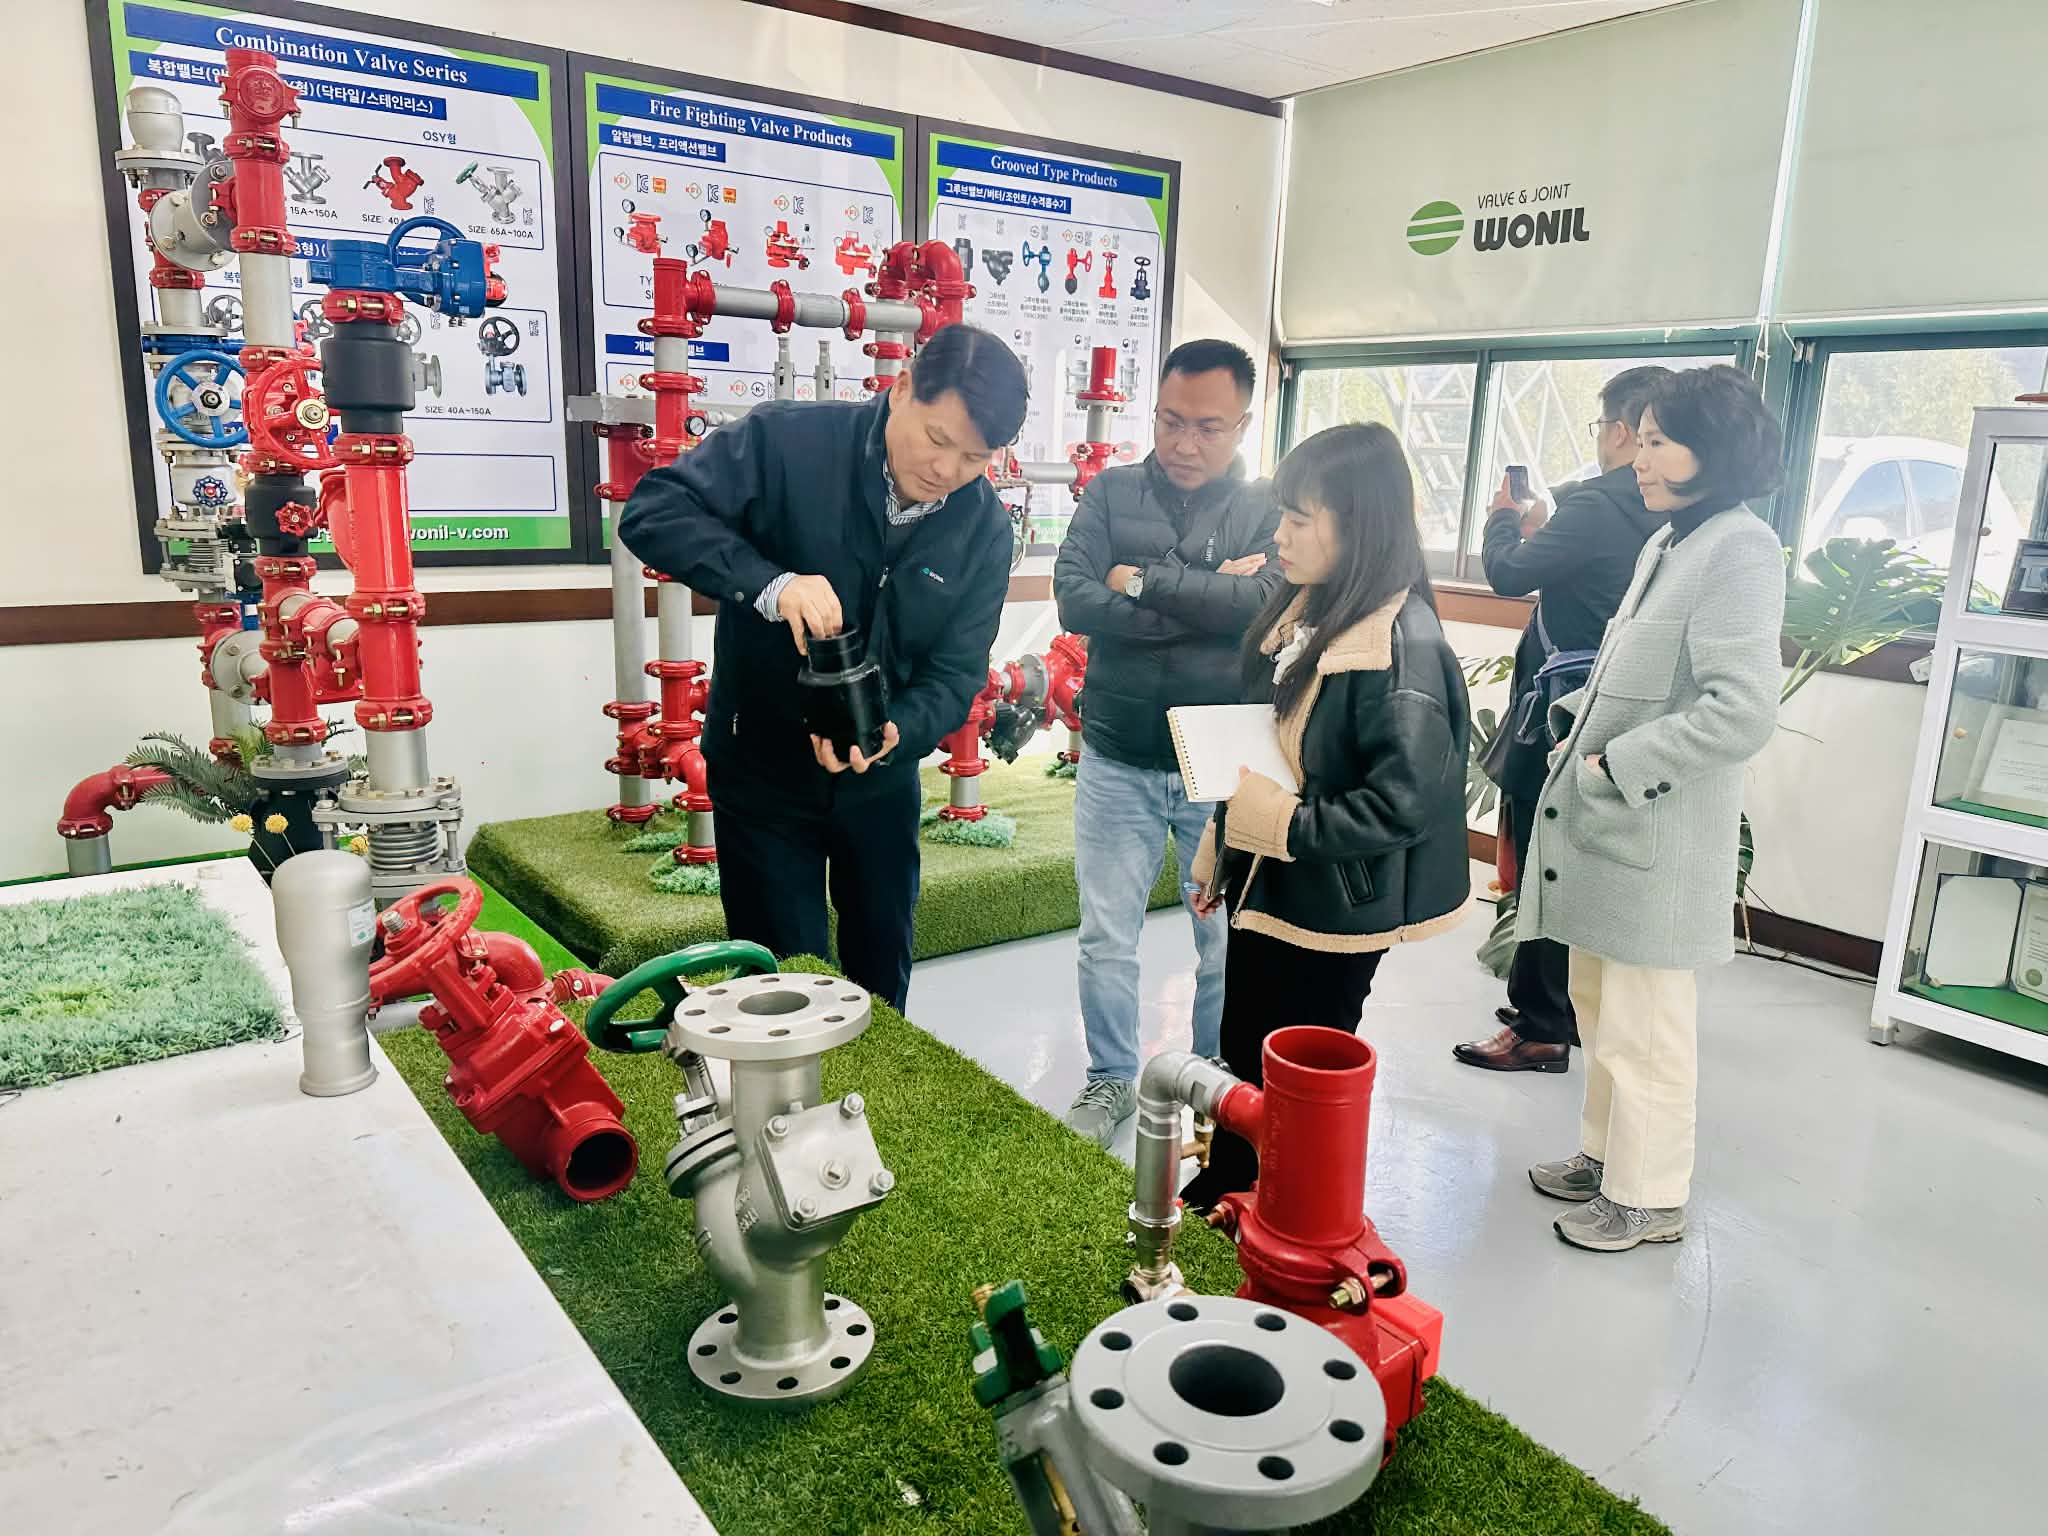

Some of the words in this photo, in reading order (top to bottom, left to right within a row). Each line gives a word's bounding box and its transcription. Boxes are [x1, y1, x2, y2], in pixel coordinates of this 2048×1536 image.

[215, 26, 349, 65] Combination
[353, 48, 409, 74] Valve
[413, 58, 469, 83] Series
[649, 98, 681, 119] Fire
[685, 105, 747, 133] Fighting
[750, 116, 790, 137] Valve
[793, 123, 853, 148] Products
[990, 154, 1040, 177] Grooved
[1041, 162, 1069, 182] Type
[1071, 169, 1119, 188] Products
[1477, 191, 1516, 210] VALVE
[1518, 189, 1528, 204] &
[1530, 183, 1572, 203] JOINT
[1472, 206, 1590, 252] WONIL
